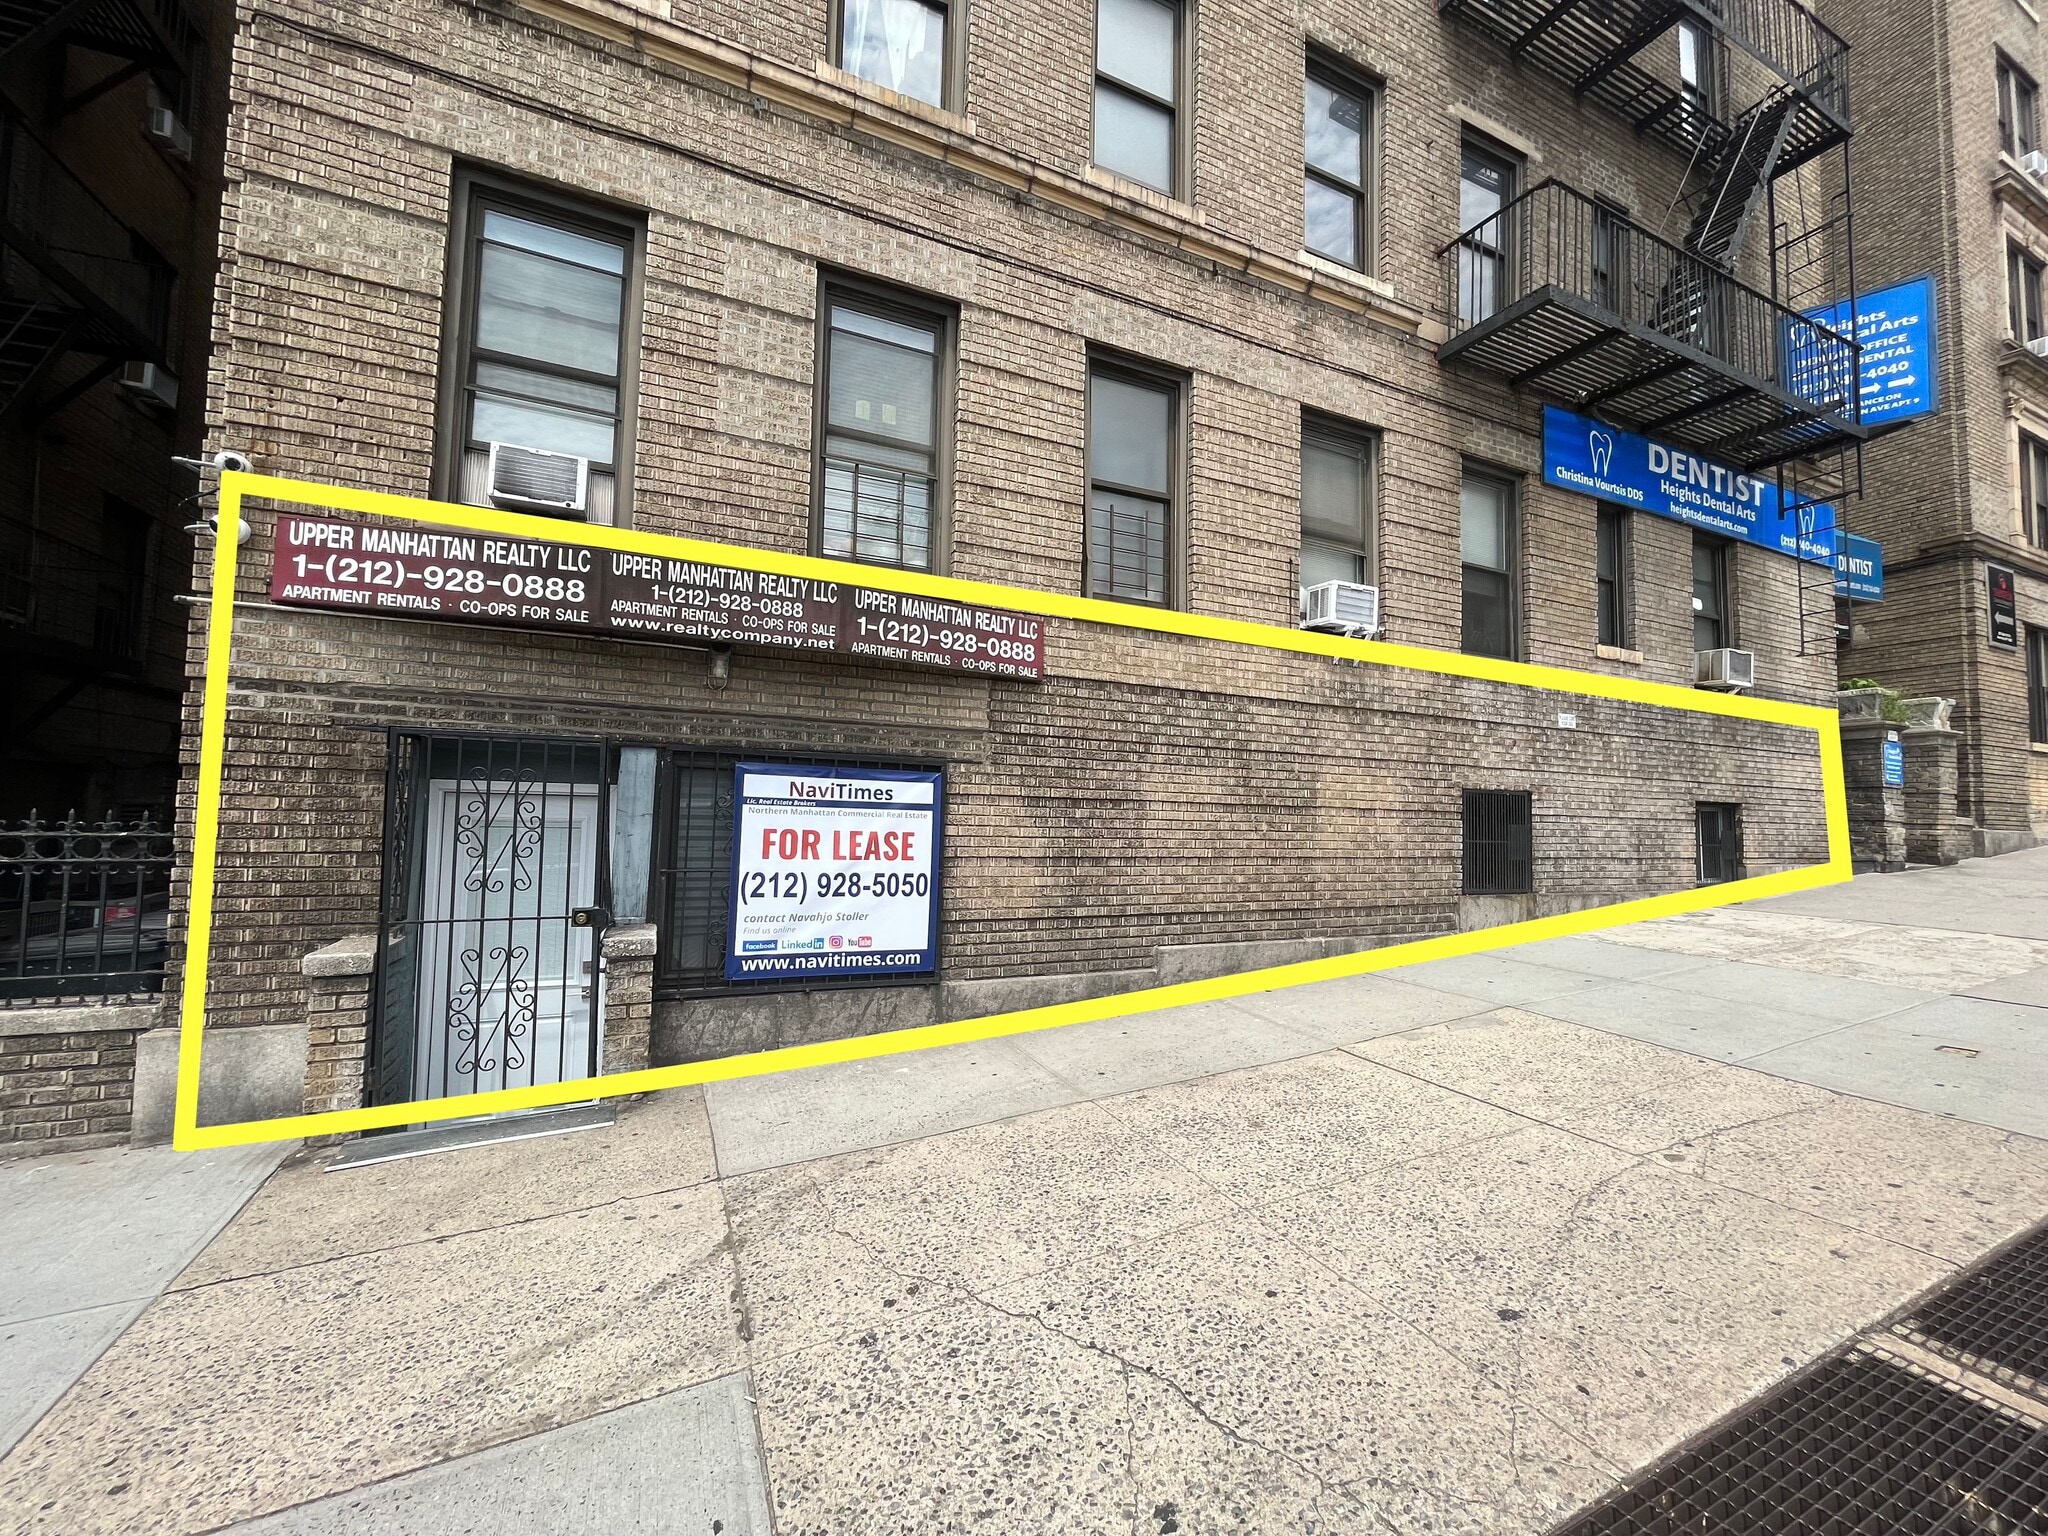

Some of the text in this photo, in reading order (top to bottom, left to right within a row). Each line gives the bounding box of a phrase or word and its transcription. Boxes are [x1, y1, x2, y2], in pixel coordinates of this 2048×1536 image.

[1879, 315, 1919, 332] Arts
[1870, 403, 1890, 413] AVE
[1891, 398, 1912, 409] APT
[1885, 392, 1902, 402] ON
[1556, 466, 1644, 501] Christina Vourtsis DDS
[1648, 443, 1765, 507] DENTIST
[1661, 479, 1756, 521] Heights Dental Arts
[1670, 501, 1748, 534] heightsdentalarts.com
[289, 520, 591, 573] UPPER MANHATTAN REALTY LLC
[1780, 533, 1830, 556] (212) 40-4040
[292, 553, 586, 603] 1-(212)-928-0888
[612, 553, 838, 604] UPPER MANHATTAN REALTY LLC
[282, 584, 589, 623] APARTMENT RENTALS CO-OPS FOR SALE
[611, 599, 836, 637] APARTMENT RENTALS CO-OPS FOR SALE
[651, 584, 804, 618] 1-(212)-928-0888
[854, 588, 1038, 640] UPPER MANHATTAN REALTY LLC
[611, 616, 835, 650] www.realtycompany.net
[857, 616, 1035, 662] 1-(212)-928-0888
[851, 642, 1038, 678] APARTMENT RENTALS CO-OPS FOR SALE
[789, 781, 893, 801] NaviTimes
[748, 806, 788, 815] Northern
[790, 808, 835, 816] Manhattan
[838, 810, 884, 818] Commercial
[761, 828, 915, 861] FOR LEASE
[741, 871, 928, 905] (212) 928-5050
[743, 912, 870, 924] contact Navahjo Stoller
[743, 926, 760, 934] Find
[773, 926, 796, 934] online
[741, 952, 921, 971] www.navitimes.com
[745, 942, 776, 950] facebook
